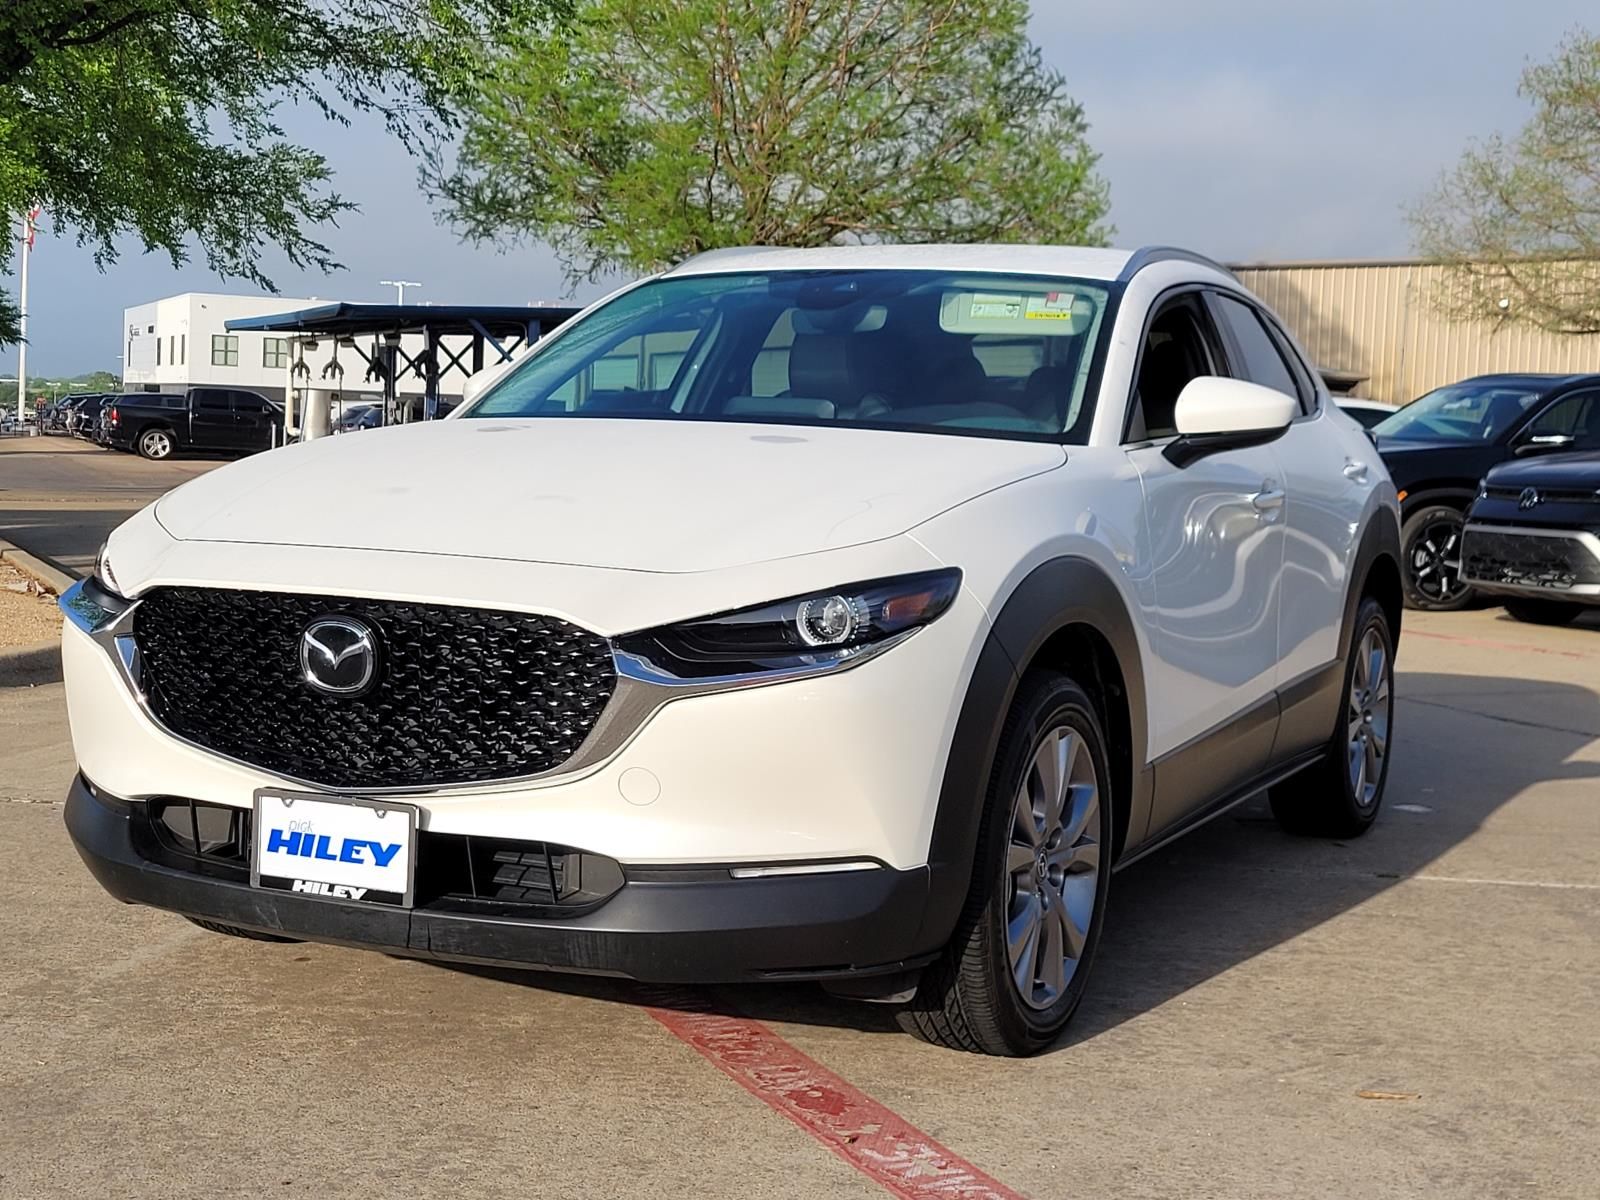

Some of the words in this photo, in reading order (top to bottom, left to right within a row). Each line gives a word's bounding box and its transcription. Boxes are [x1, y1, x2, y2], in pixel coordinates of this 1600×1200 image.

[288, 819, 313, 833] pick
[267, 829, 402, 867] HILEY
[292, 880, 368, 900] HILEY
